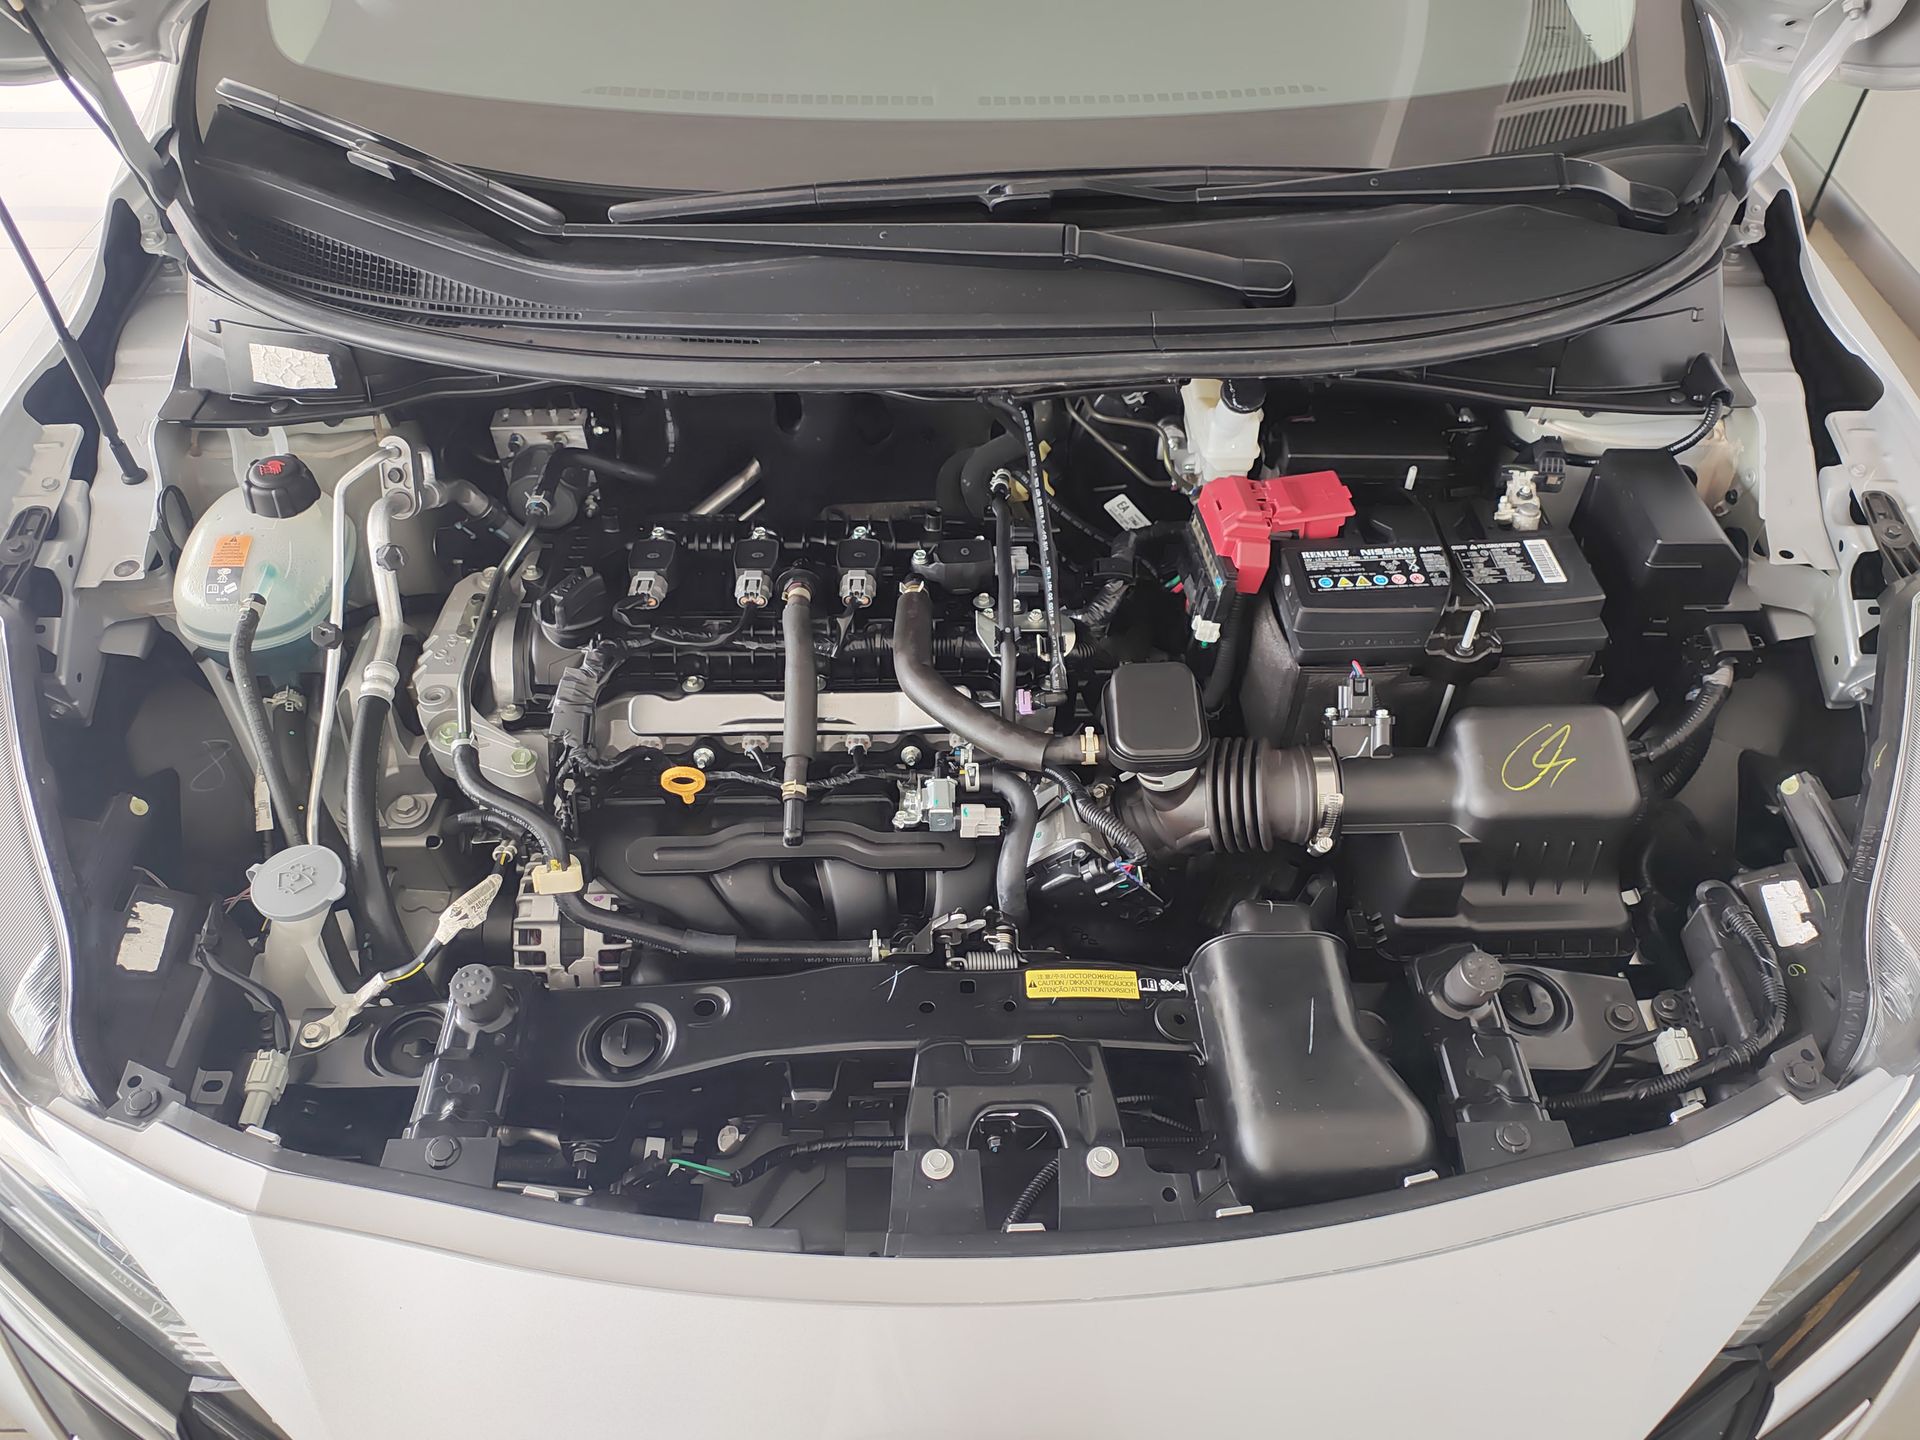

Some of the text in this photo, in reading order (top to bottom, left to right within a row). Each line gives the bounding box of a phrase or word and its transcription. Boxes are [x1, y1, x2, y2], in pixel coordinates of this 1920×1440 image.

[1300, 549, 1349, 559] RENAULT
[1359, 546, 1415, 556] NISSAN
[1037, 979, 1064, 987] CAUTION
